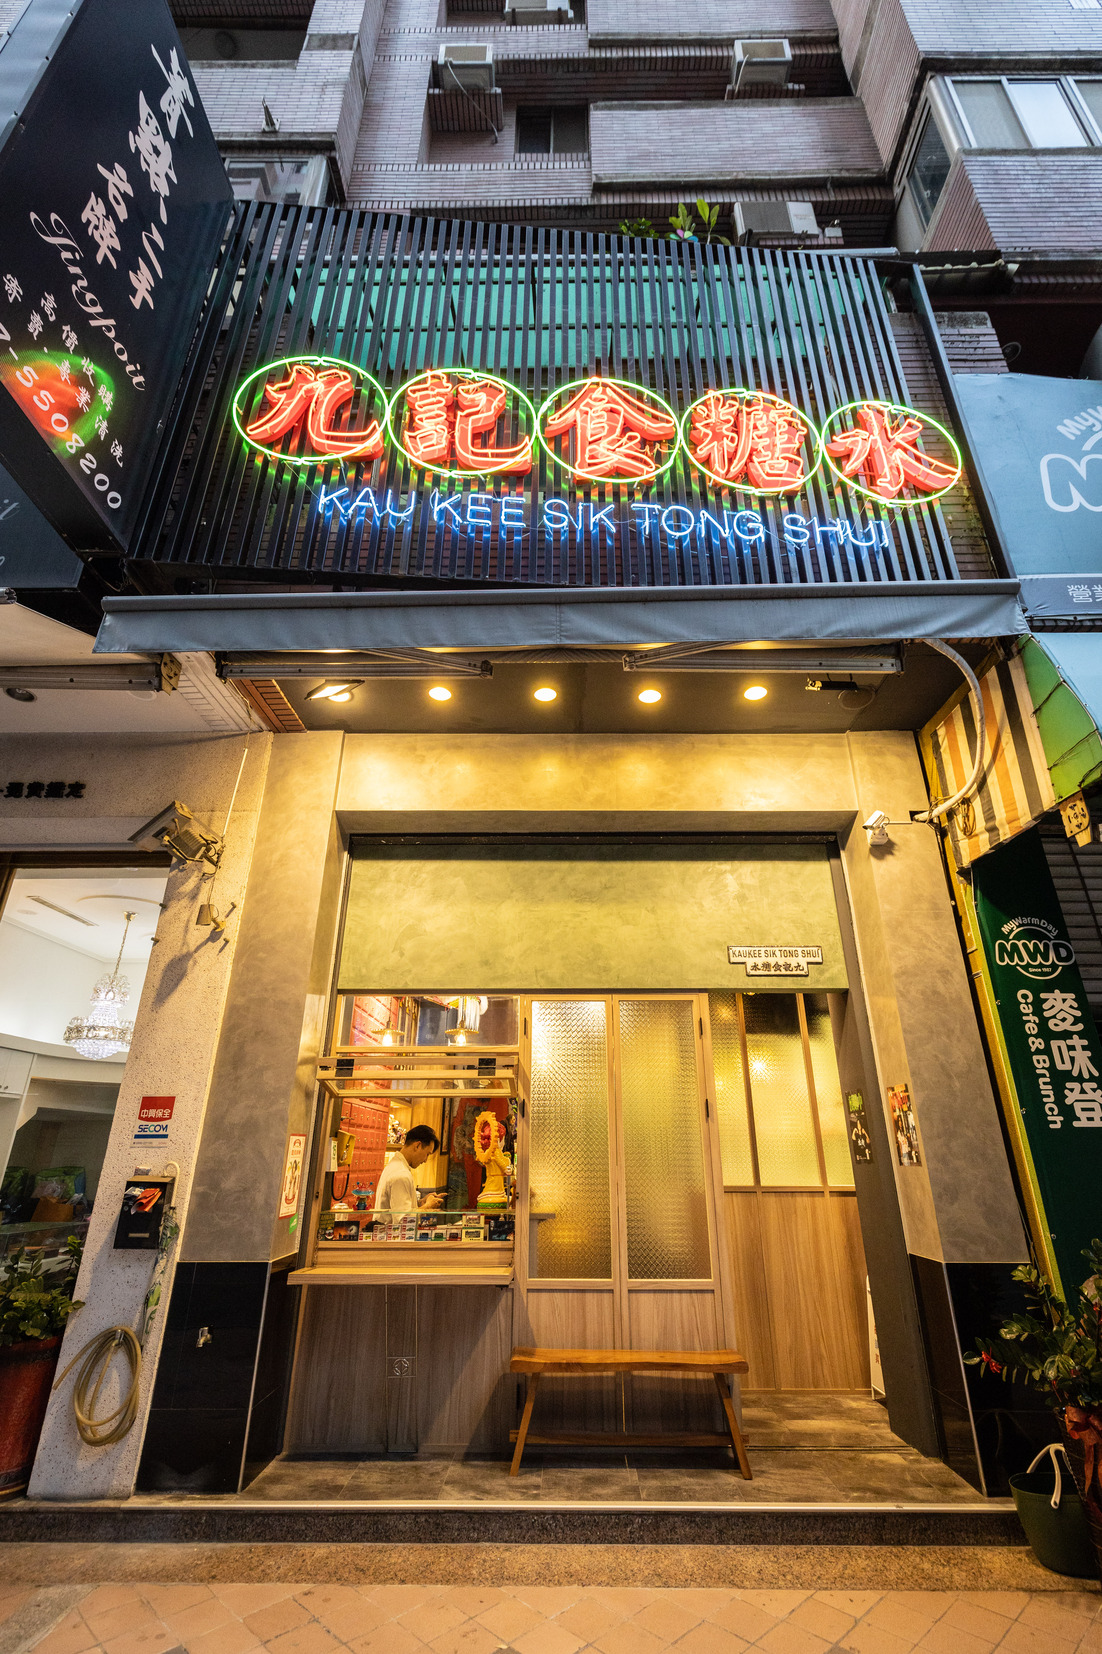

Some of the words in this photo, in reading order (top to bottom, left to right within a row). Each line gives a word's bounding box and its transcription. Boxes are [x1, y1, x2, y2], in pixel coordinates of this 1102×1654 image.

[81, 161, 134, 270] 名牌
[29, 210, 146, 391] Jingpoit
[129, 222, 165, 310] 二手
[41, 291, 114, 412] 高價收購
[245, 364, 963, 500] 九記食糖水
[318, 485, 416, 518] KAU
[433, 487, 526, 528] KEE
[543, 498, 616, 533] SIK
[631, 503, 765, 543] TONG
[784, 513, 890, 548] SHUI
[763, 949, 777, 958] SIK
[778, 949, 799, 958] TONG
[800, 948, 820, 958] SHUI
[995, 939, 1075, 966] MWD
[1016, 989, 1039, 1035] Cafe
[1028, 1036, 1045, 1052] &
[1032, 1054, 1064, 1129] Brunch
[1039, 988, 1102, 1128] 麥味登
[137, 1124, 168, 1133] SECOM
